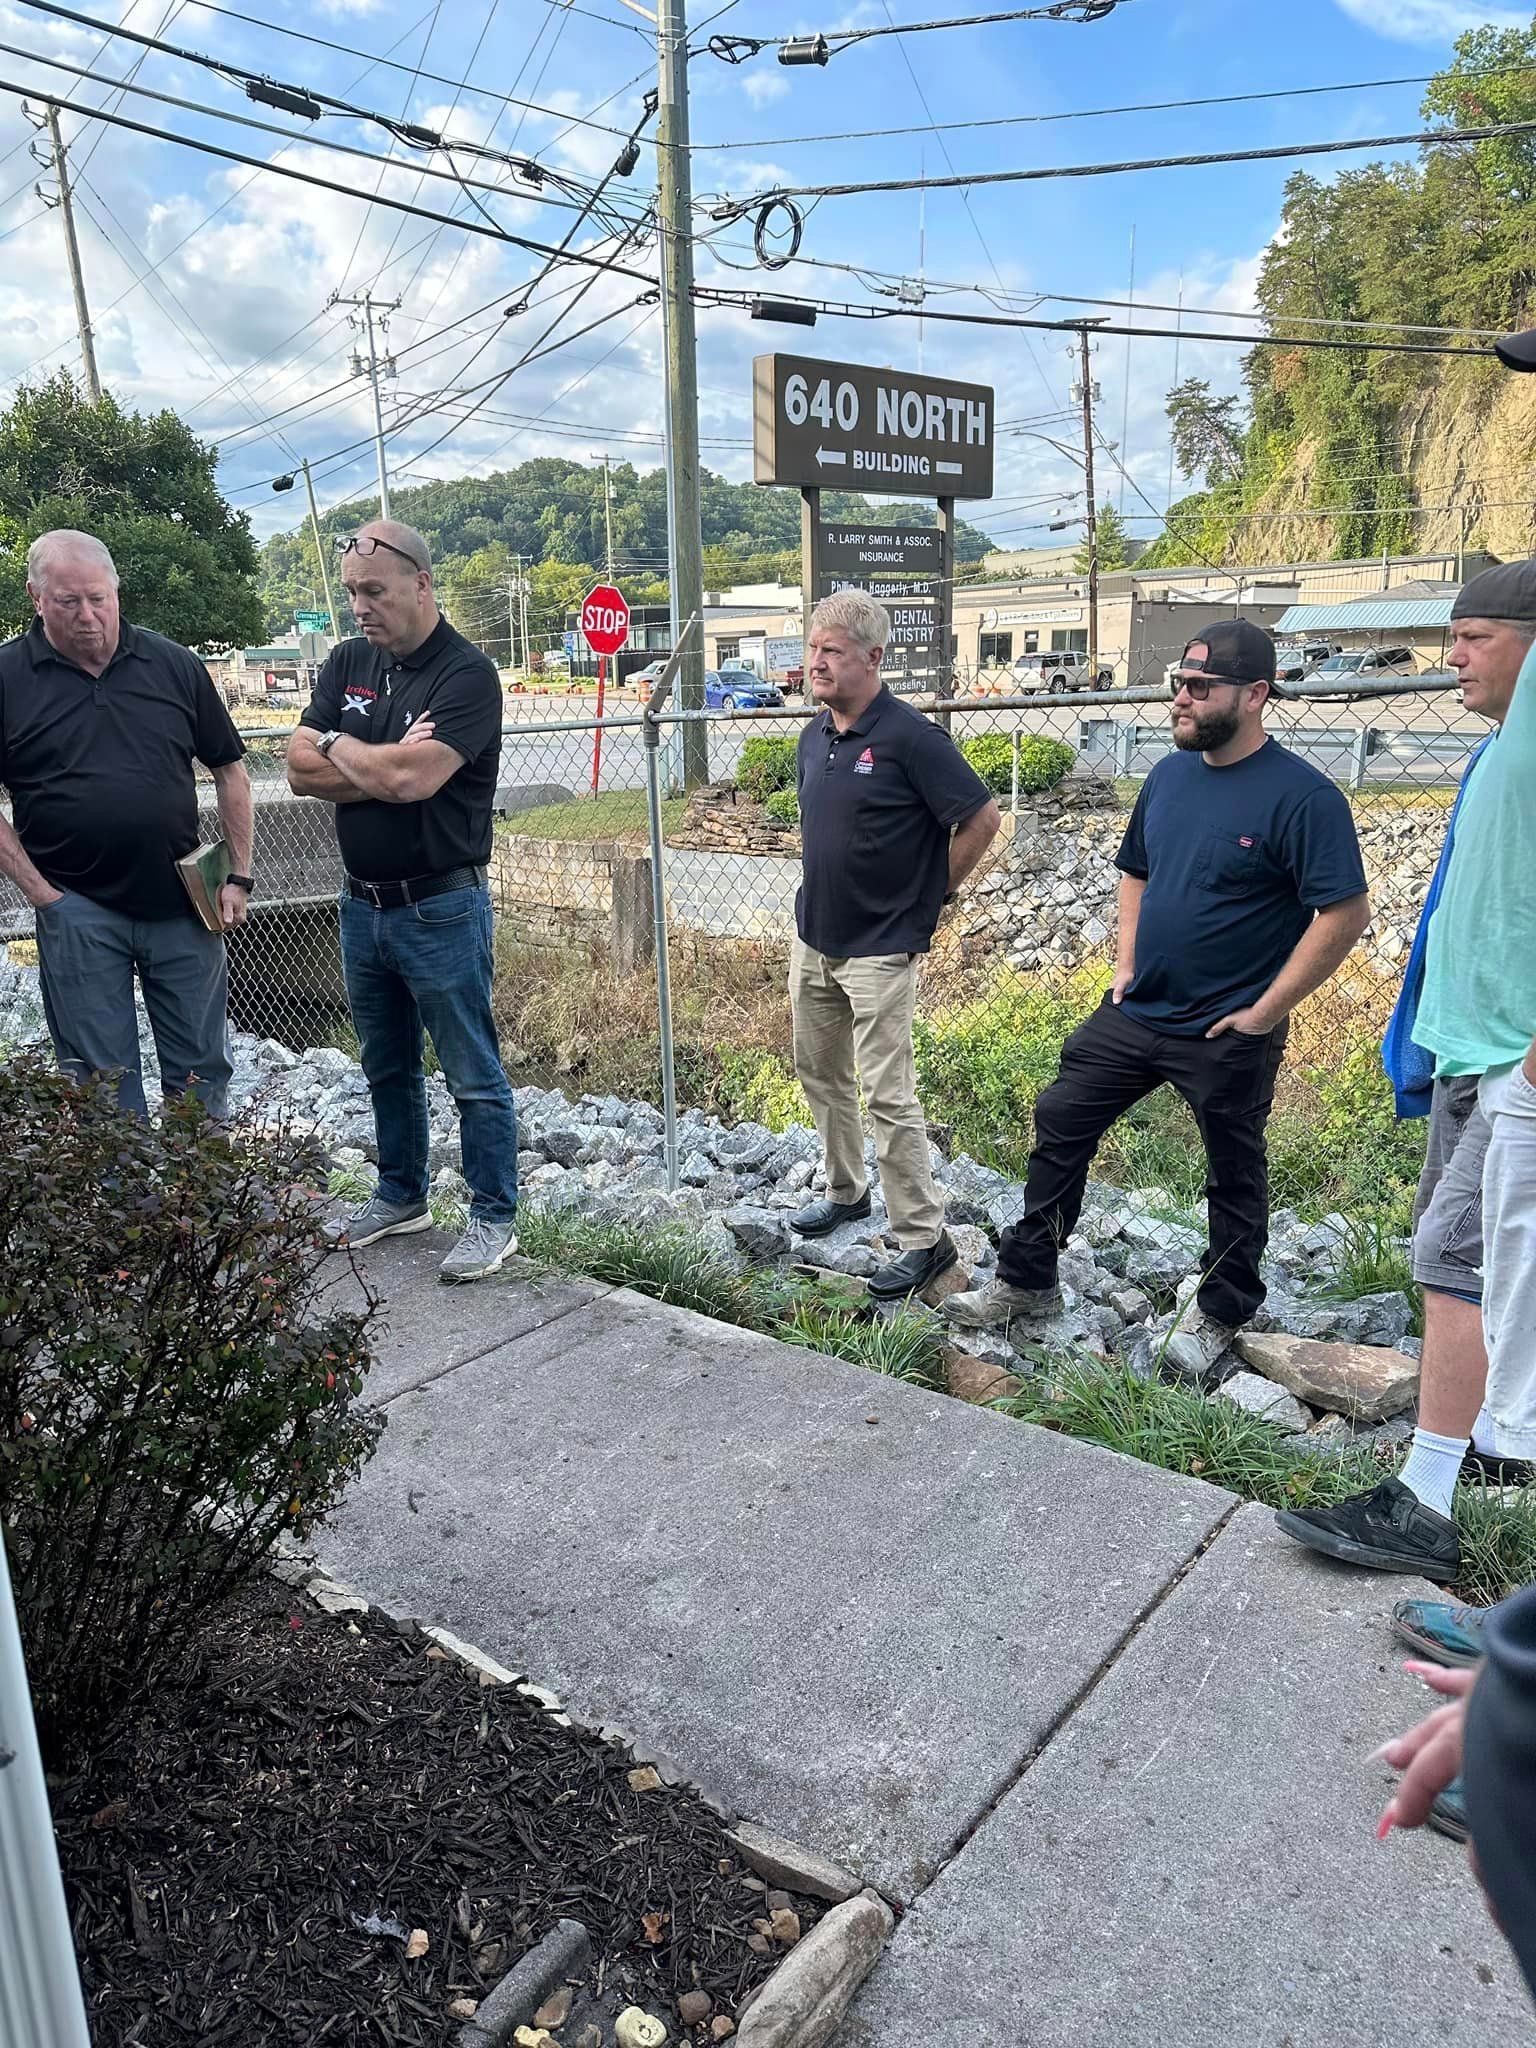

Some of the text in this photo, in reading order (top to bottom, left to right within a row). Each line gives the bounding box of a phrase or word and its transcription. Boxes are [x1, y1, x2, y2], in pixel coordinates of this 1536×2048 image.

[785, 374, 986, 446] 640 NORTH
[853, 450, 930, 475] BUILDING
[828, 533, 933, 547] R. LARRY SMITH & ASSOC.
[859, 551, 904, 562] INSURANCE
[584, 604, 626, 636] STOP
[894, 609, 934, 625] DENTAL
[888, 627, 934, 642] NTISTRY
[880, 654, 908, 664] HER
[887, 679, 927, 691] ounseling
